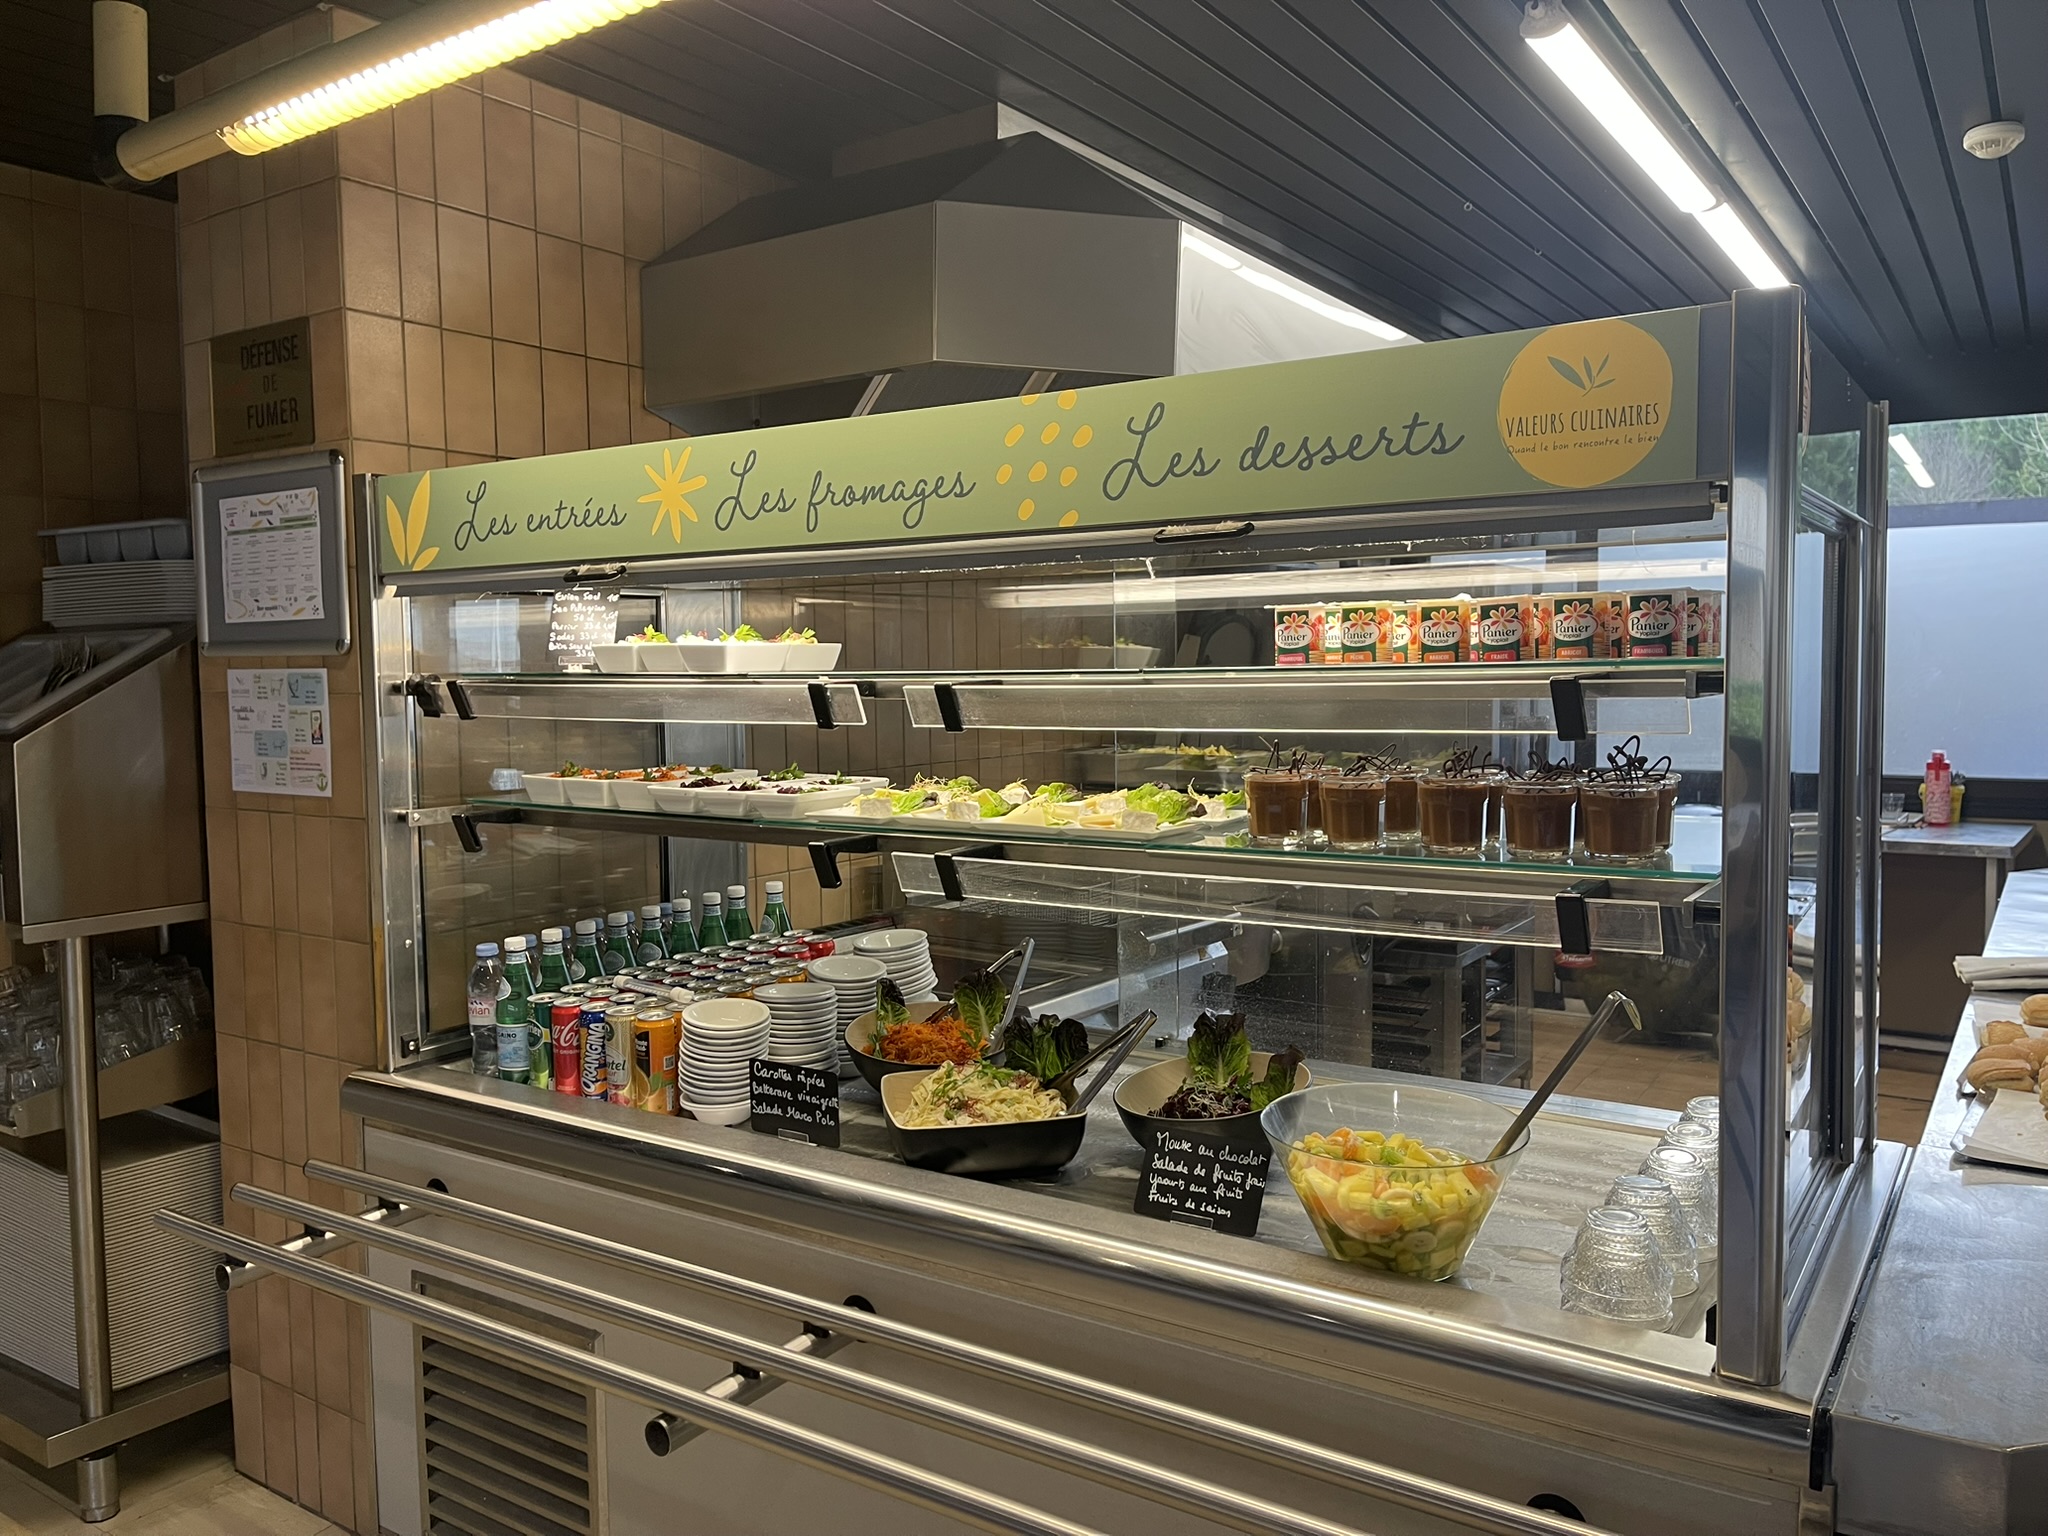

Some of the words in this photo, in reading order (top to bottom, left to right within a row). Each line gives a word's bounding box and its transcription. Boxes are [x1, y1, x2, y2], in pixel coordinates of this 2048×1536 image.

[240, 334, 299, 371] DÉFENSE
[262, 374, 278, 393] DE
[246, 397, 299, 430] FUMER
[1505, 412, 1565, 438] VALEURS
[1570, 402, 1660, 432] CULINAIRES
[1102, 401, 1221, 501] Les
[1239, 411, 1466, 471] desserts
[1508, 443, 1536, 454] Quand
[1540, 443, 1549, 452] le
[1552, 440, 1569, 451] bon
[1573, 437, 1620, 449] rencontre
[1624, 434, 1633, 444] le
[1637, 431, 1660, 443] bien
[714, 449, 797, 532] Les
[806, 470, 977, 533] fromages
[454, 480, 518, 551] Les
[526, 497, 628, 533] entrées
[1277, 628, 1308, 642] Panier
[1343, 627, 1374, 640] Panier
[1423, 624, 1457, 639] Panier
[1482, 623, 1518, 639] Panier
[1555, 619, 1591, 634] Panier
[1629, 617, 1670, 631] Panier
[581, 1021, 607, 1094] ORANGINA
[753, 1061, 793, 1081] Carottes
[752, 1081, 794, 1100] Betterave
[752, 1100, 784, 1116] Salade
[785, 1106, 813, 1122] Marco
[815, 1110, 835, 1127] Polo
[1156, 1131, 1193, 1152] Mousse
[1198, 1144, 1215, 1158] au
[1219, 1144, 1267, 1166] chocolat
[1151, 1153, 1188, 1175] Salade
[1193, 1163, 1206, 1177] de
[1212, 1163, 1245, 1184] fruits
[1149, 1172, 1185, 1191] Yaourts
[1189, 1183, 1208, 1195] aux
[1212, 1182, 1244, 1200] fruits
[1184, 1198, 1196, 1210] de
[1199, 1201, 1232, 1218] saison
